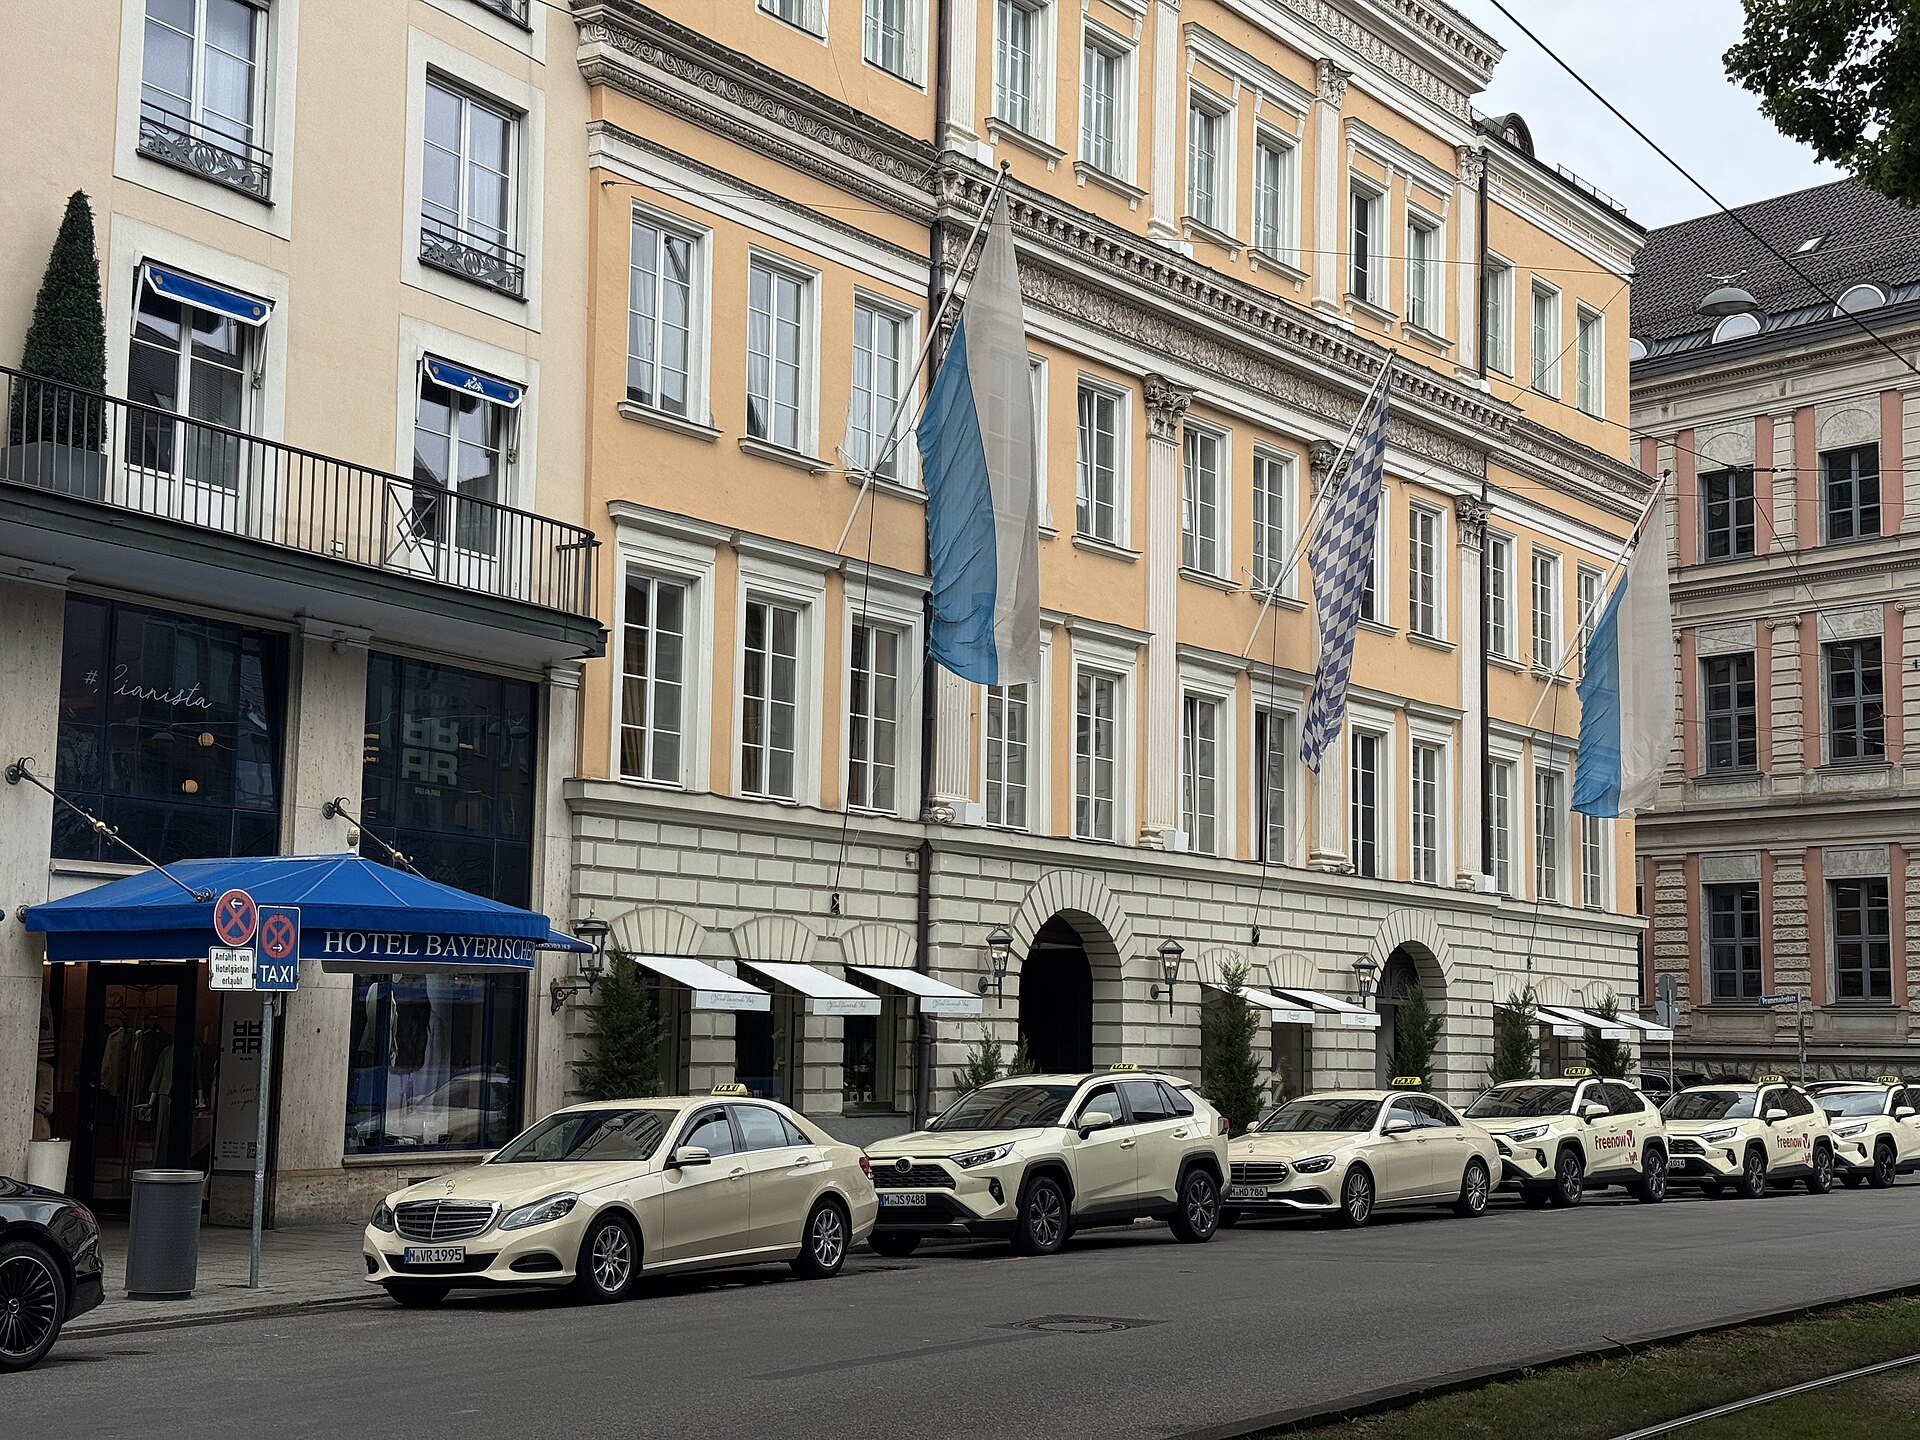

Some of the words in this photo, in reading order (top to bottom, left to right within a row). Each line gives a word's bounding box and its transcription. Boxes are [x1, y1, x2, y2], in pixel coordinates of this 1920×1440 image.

[415, 786, 441, 797] RIANI
[322, 931, 419, 956] HOTEL
[424, 934, 536, 961] BAYERISCHER
[214, 952, 237, 961] Anfahrt
[215, 964, 249, 975] Hotelgästen
[259, 964, 294, 983] TAXI
[222, 976, 243, 985] erlaubt
[715, 1084, 740, 1092] TAXI
[1594, 1135, 1626, 1150] freenow
[1776, 1135, 1802, 1149] freenow
[435, 1249, 462, 1261] 1995
